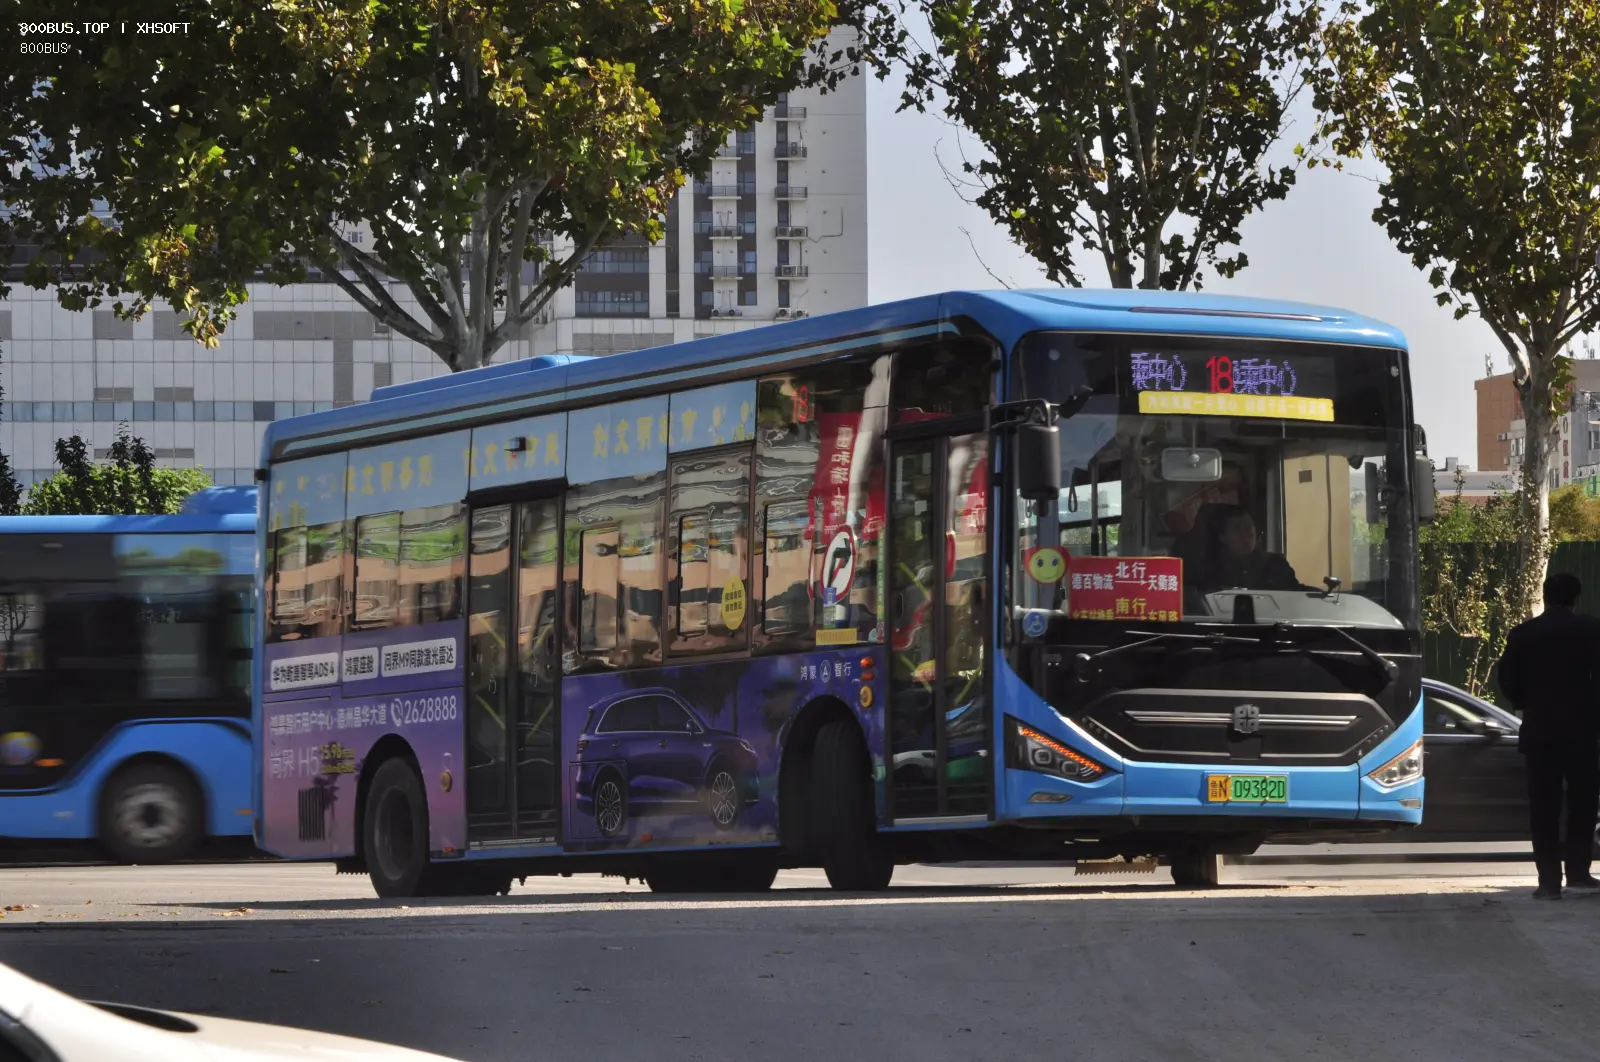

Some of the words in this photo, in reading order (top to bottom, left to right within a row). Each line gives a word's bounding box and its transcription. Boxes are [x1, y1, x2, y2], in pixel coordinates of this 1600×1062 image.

[1205, 355, 1232, 393] 18
[1071, 573, 1114, 590] 德百物流
[1115, 561, 1147, 579] 北行
[1115, 597, 1147, 615] 南行
[404, 696, 457, 724] 2628888
[298, 745, 319, 776] H5
